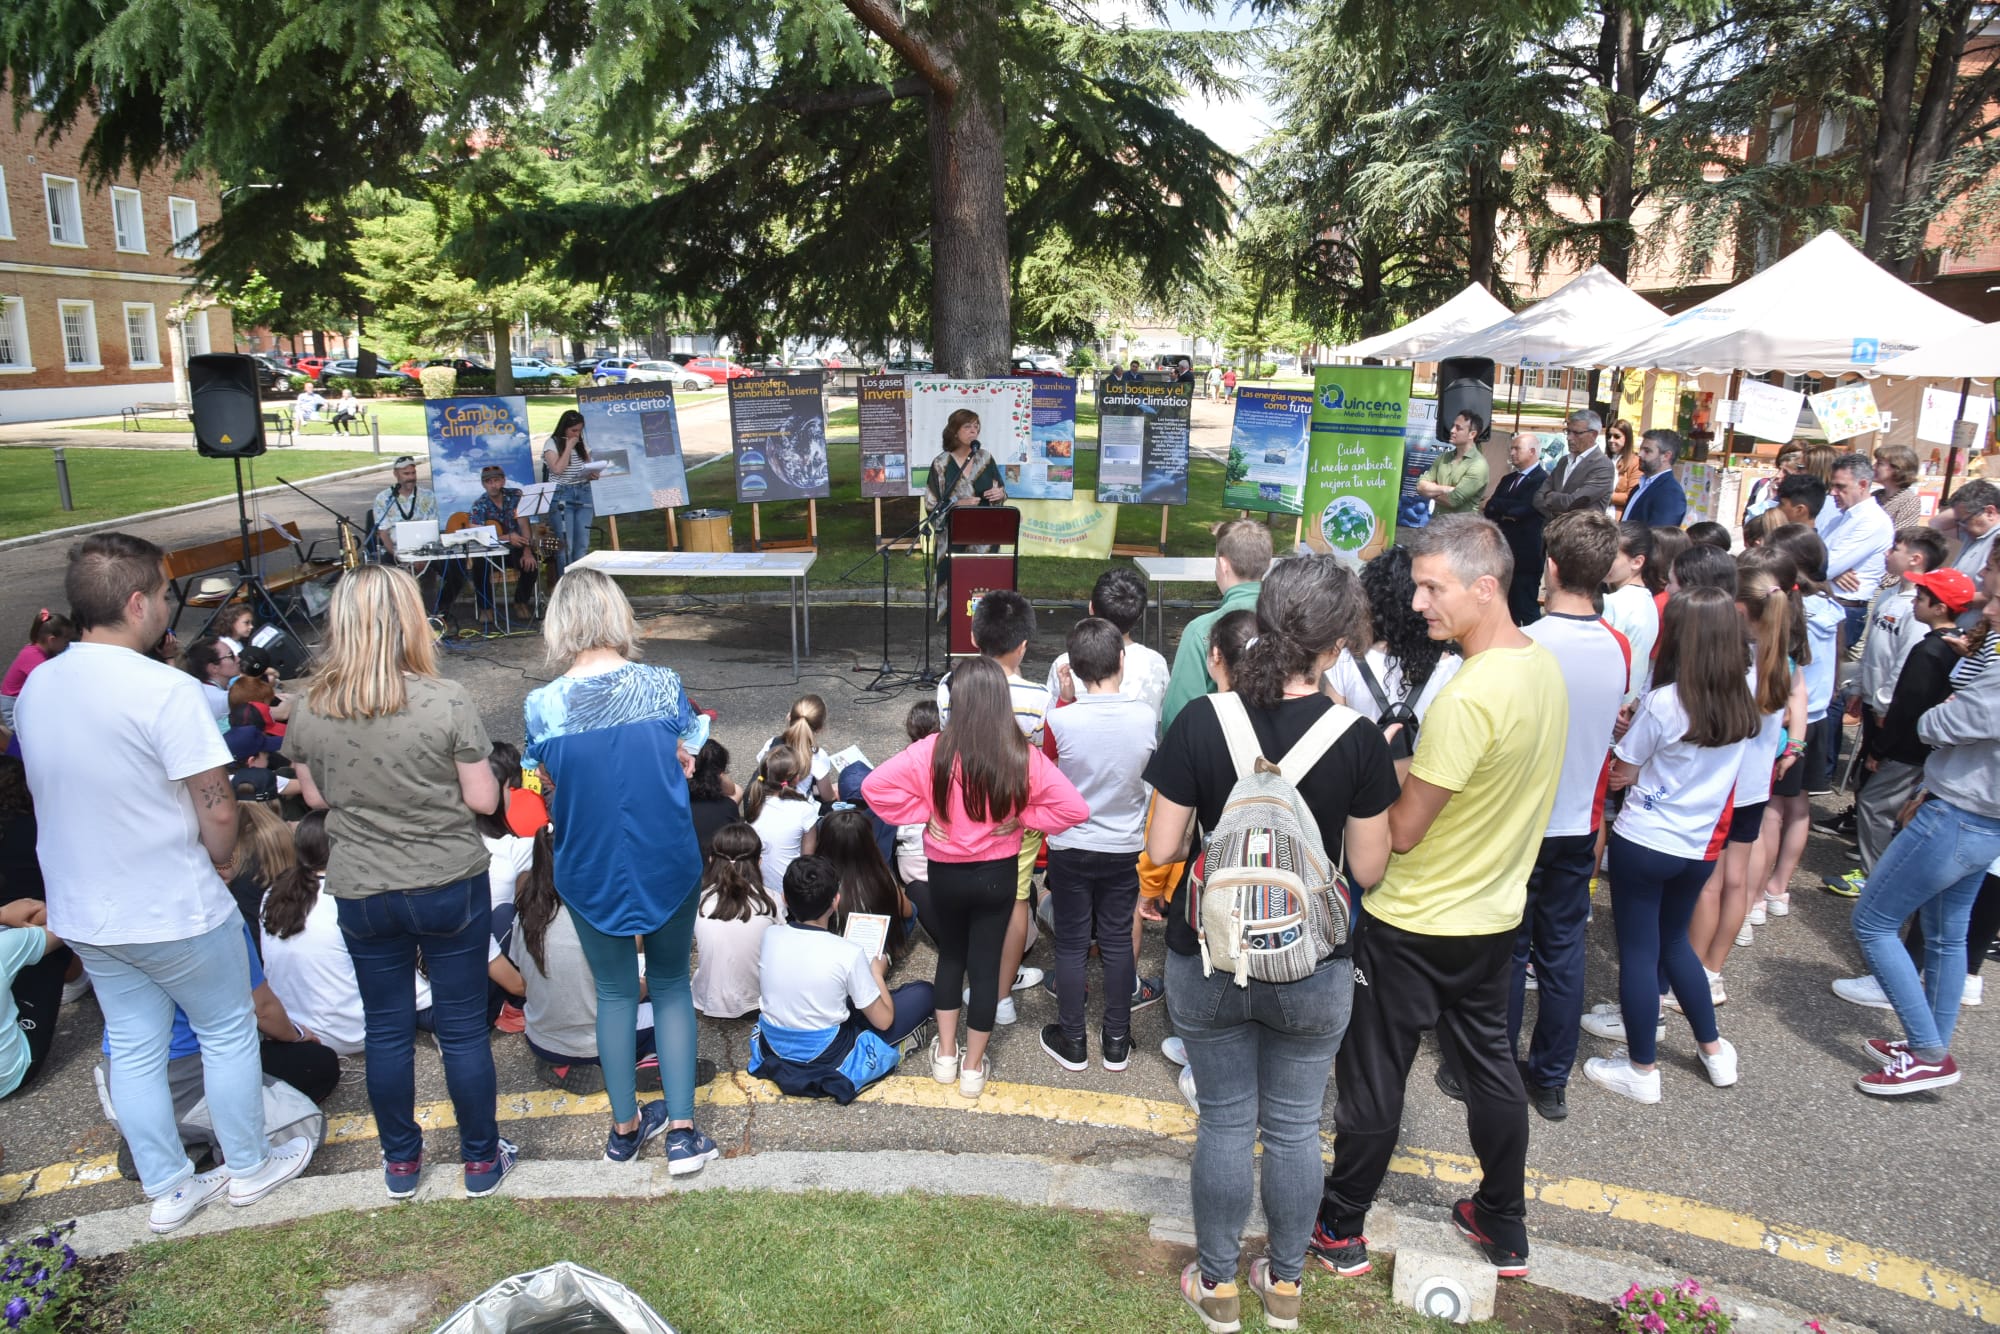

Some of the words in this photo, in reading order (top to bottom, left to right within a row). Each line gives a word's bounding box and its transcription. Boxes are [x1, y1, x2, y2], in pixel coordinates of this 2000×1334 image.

[732, 381, 743, 390] La
[862, 378, 877, 387] Los
[878, 379, 903, 389] gases
[1040, 382, 1072, 391] cambios
[1106, 383, 1122, 393] Los
[1125, 384, 1165, 396] bosques
[1167, 387, 1173, 395] y
[1175, 385, 1184, 394] el
[580, 394, 588, 403] El
[590, 393, 623, 403] cambio
[624, 389, 665, 400] climático
[733, 388, 773, 398] sombrilla
[775, 387, 786, 396] de
[864, 388, 912, 400] inverna
[1240, 389, 1253, 398] Las
[1254, 391, 1286, 401] energías
[1287, 394, 1313, 403] renova
[1323, 384, 1402, 412] Quincena
[607, 402, 627, 416] ¿es
[629, 395, 671, 411] cierto?
[1103, 394, 1140, 405] cambio
[1142, 395, 1188, 407] climático
[445, 404, 508, 422] Cambio
[1264, 402, 1288, 410] como
[1289, 401, 1312, 414] futu
[1343, 410, 1365, 418] Medio
[1368, 411, 1402, 419] Ambiente
[441, 420, 515, 438] climático
[1337, 440, 1365, 456] Cuida
[1310, 459, 1318, 473] el
[1321, 457, 1349, 474] medio
[1320, 479, 1351, 494] mejora
[1352, 474, 1362, 487] tu
[1366, 472, 1386, 488] vida
